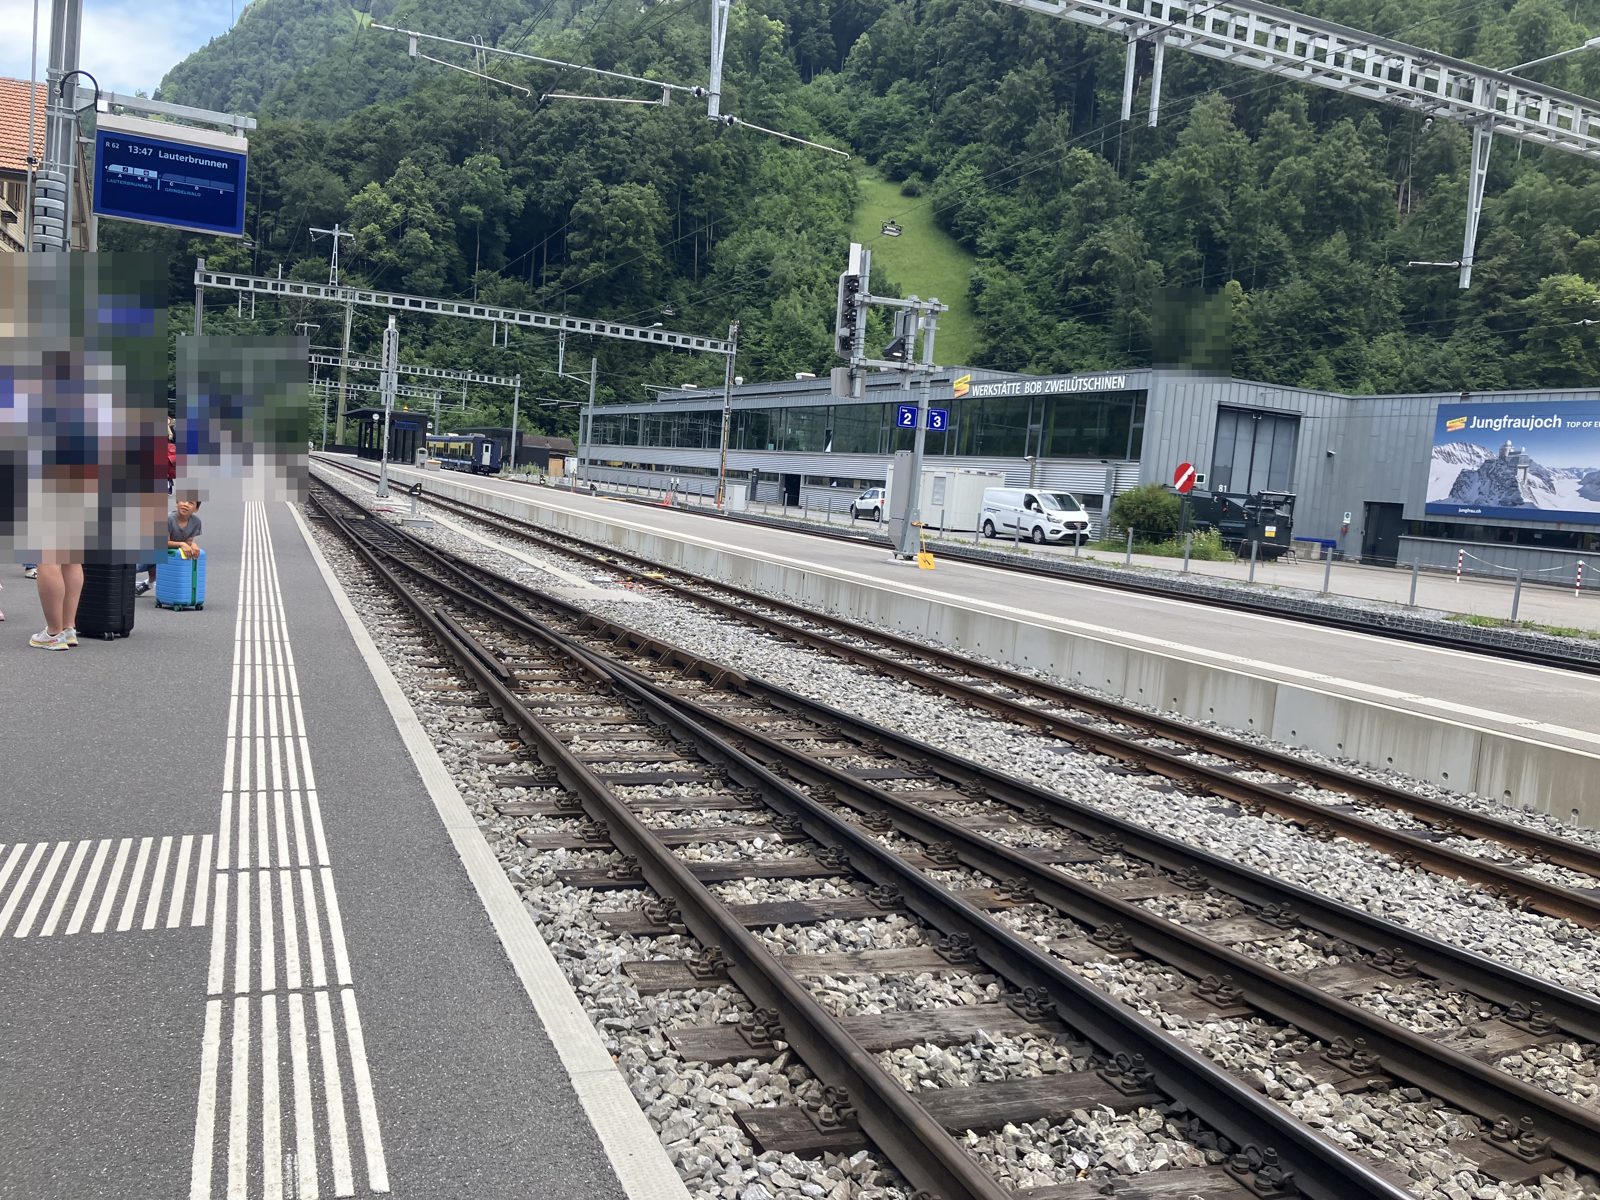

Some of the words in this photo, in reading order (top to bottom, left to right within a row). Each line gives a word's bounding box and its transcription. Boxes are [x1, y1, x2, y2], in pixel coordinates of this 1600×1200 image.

[128, 145, 153, 156] 13:47
[158, 150, 228, 169] Lauterbrunnen
[106, 178, 152, 189] LAUTERBRUNNEN
[165, 187, 201, 197] GRINDELWALD
[972, 381, 1020, 396] WERKSTÄTTE
[1024, 381, 1042, 394] BOB
[1044, 375, 1126, 393] ZWEILÜTSCHINEN
[903, 413, 912, 424] 2
[933, 416, 941, 427] 3
[1469, 414, 1562, 431] Jungfraujoch
[1218, 484, 1227, 492] 81
